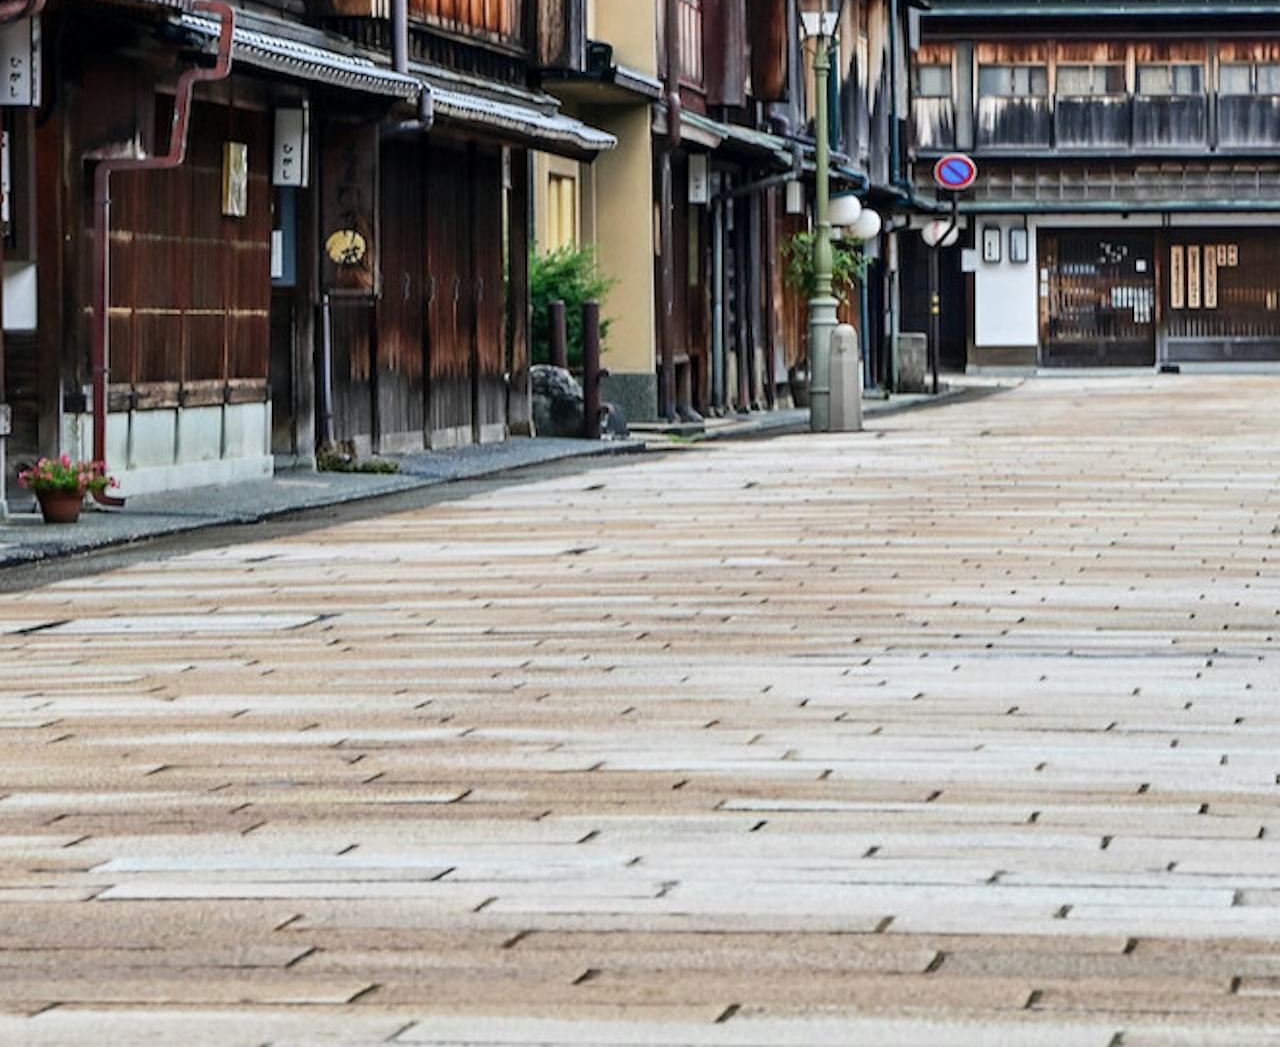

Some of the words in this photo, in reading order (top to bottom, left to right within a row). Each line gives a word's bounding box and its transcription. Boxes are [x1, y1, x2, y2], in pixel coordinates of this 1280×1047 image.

[10, 55, 22, 98] ひがし
[282, 143, 293, 180] ひがし
